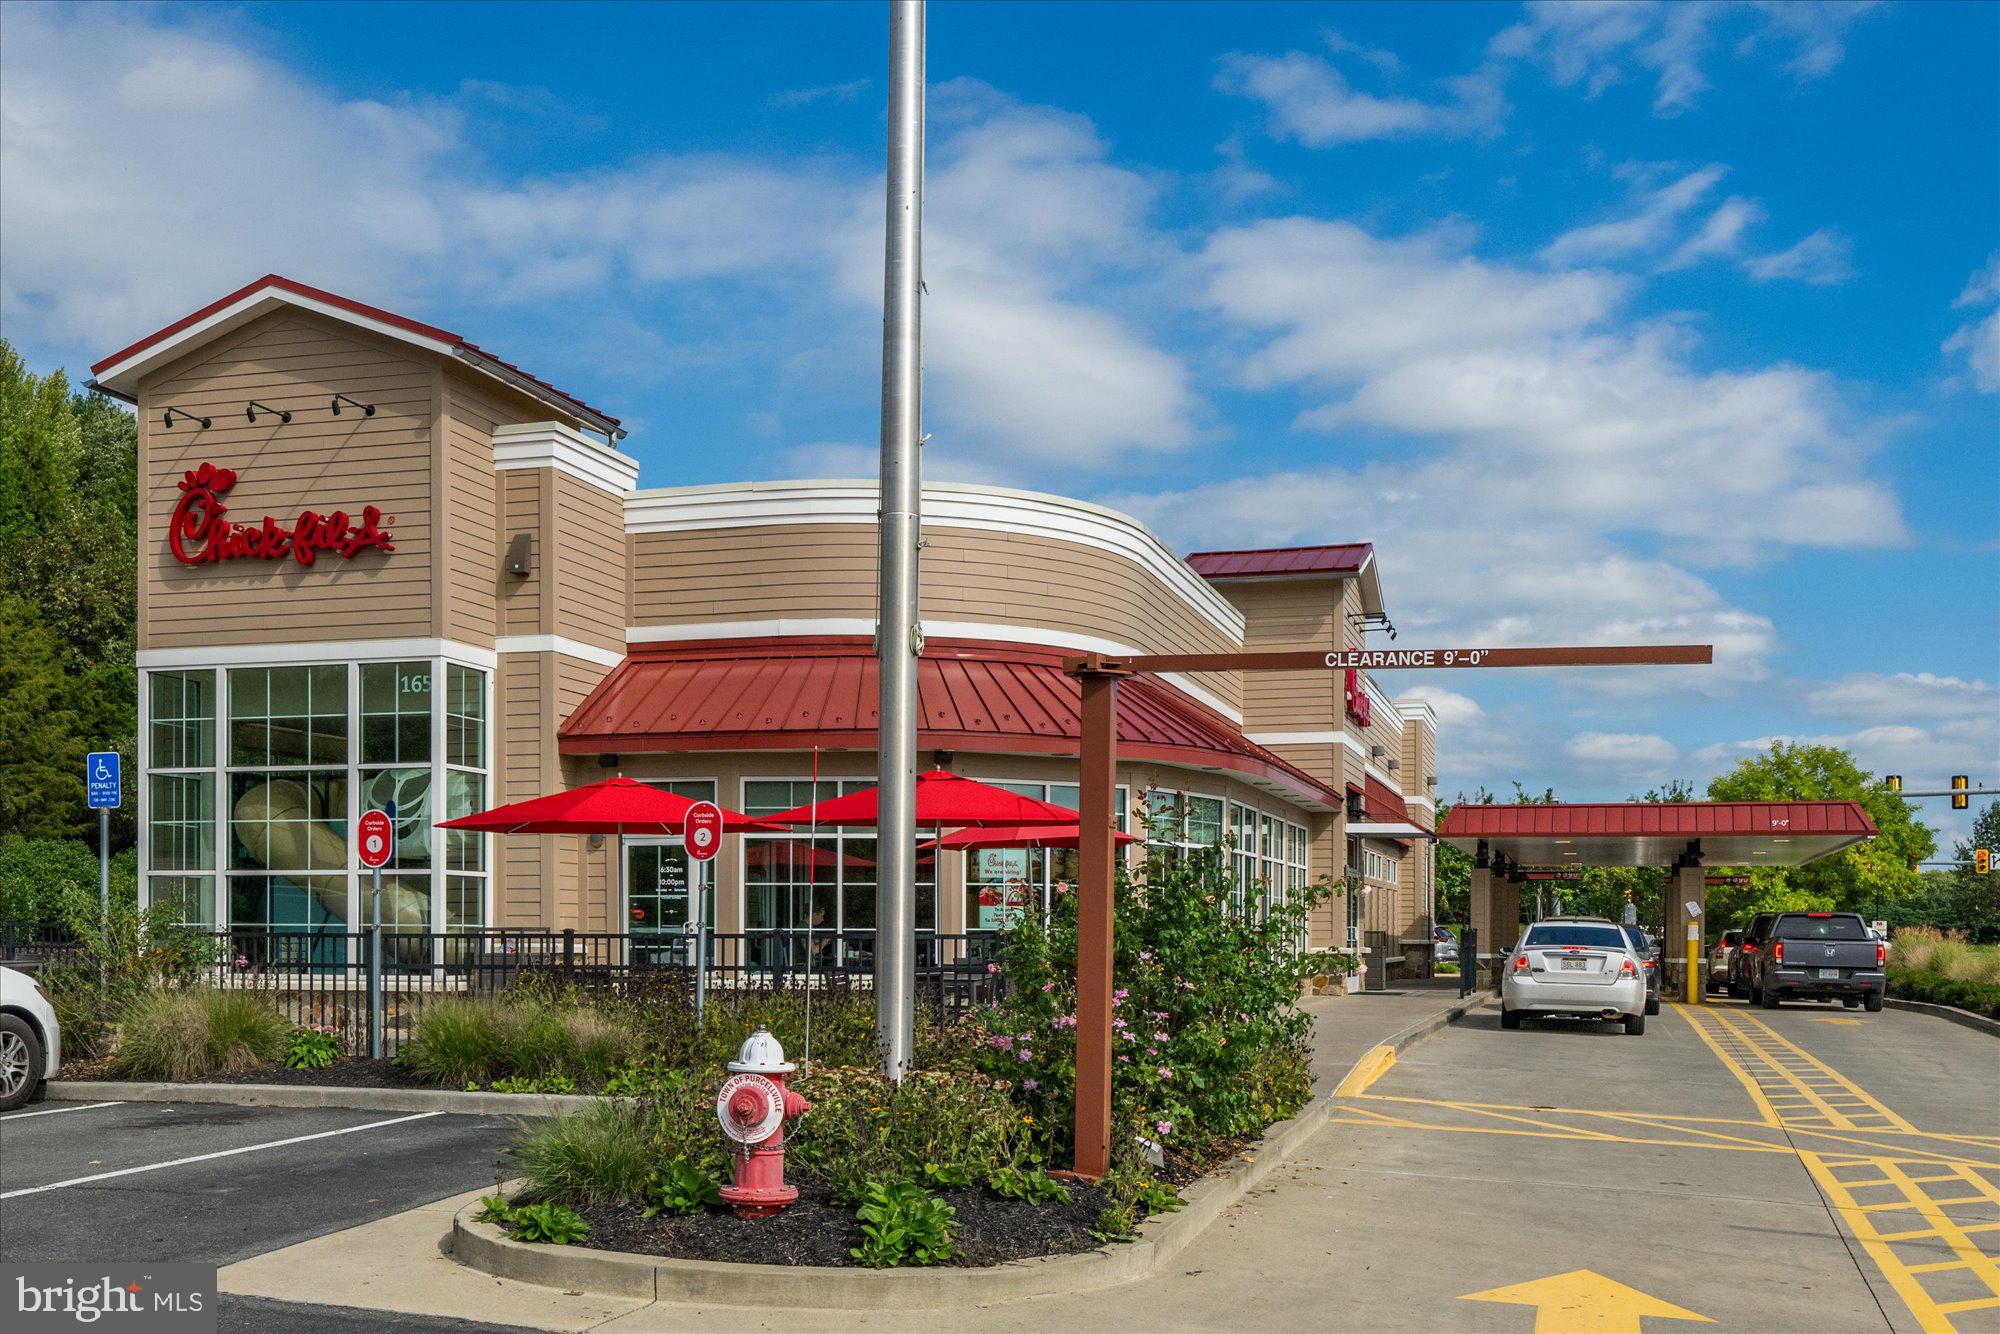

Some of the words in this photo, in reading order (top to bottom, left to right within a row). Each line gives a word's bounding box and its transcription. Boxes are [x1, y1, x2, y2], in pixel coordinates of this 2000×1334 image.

[169, 462, 395, 566] Chick-fil-A
[1325, 651, 1435, 667] CLEARANCE
[400, 674, 432, 693] 165
[372, 839, 377, 849] 1
[700, 832, 706, 842] 2
[719, 1082, 735, 1102] TOWN
[733, 1076, 743, 1085] OF
[745, 1074, 783, 1113] PURCELLVILLE
